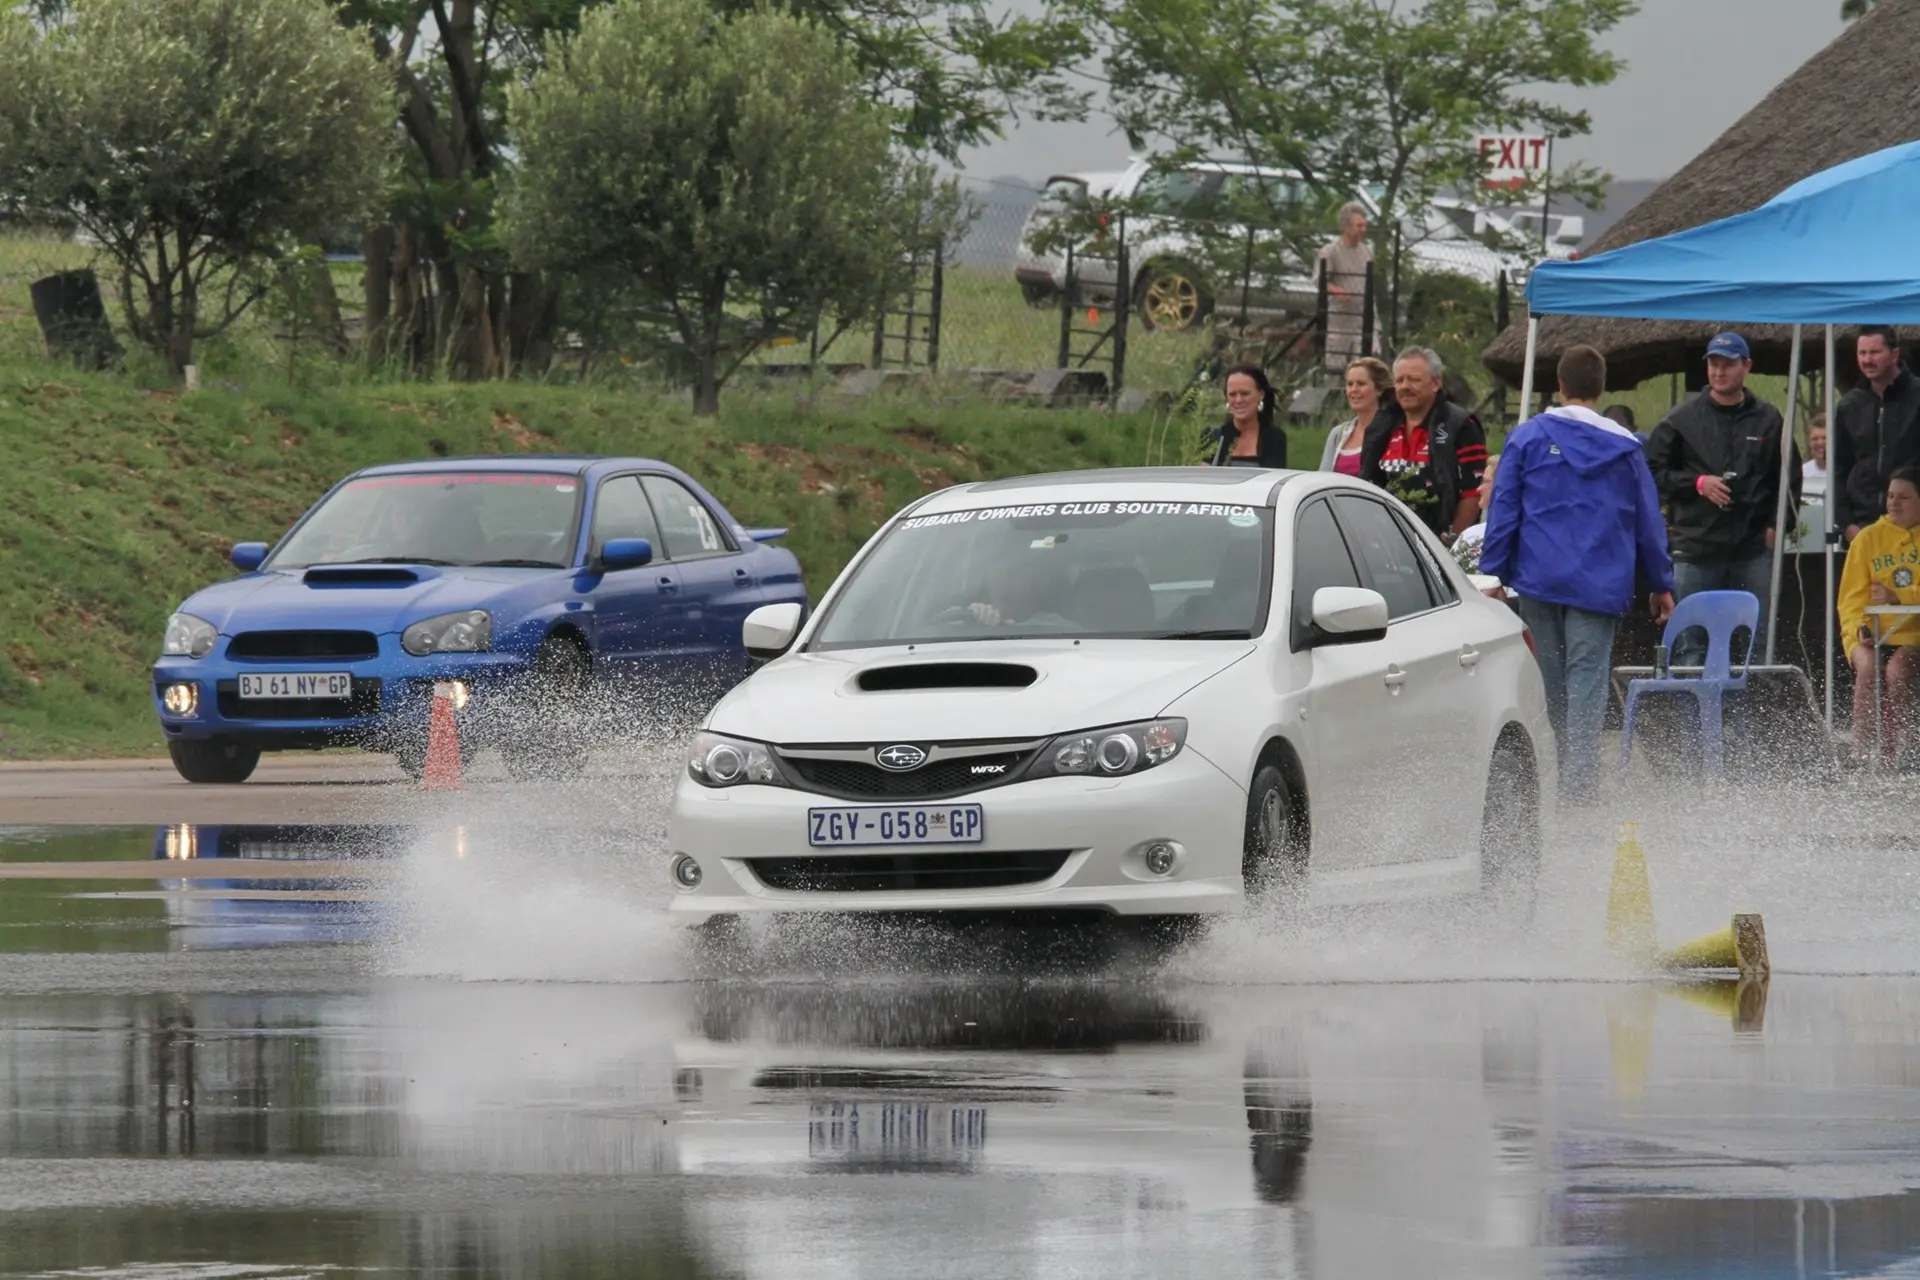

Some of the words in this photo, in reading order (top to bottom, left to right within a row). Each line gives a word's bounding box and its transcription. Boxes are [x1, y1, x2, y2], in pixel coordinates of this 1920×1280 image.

[1479, 138, 1546, 169] EXIT
[901, 511, 976, 530] SUBARU
[978, 504, 1057, 520] OWNERS
[1061, 502, 1111, 515] CLUB
[1115, 502, 1181, 514] SOUTH
[1185, 504, 1255, 518] AFRICA
[242, 676, 263, 695] BJ
[270, 676, 290, 695] 61
[297, 675, 317, 695] NY
[329, 674, 348, 694] GP
[971, 765, 1006, 774] WRX
[812, 811, 928, 841] ZGY-058
[950, 808, 979, 837] GP
